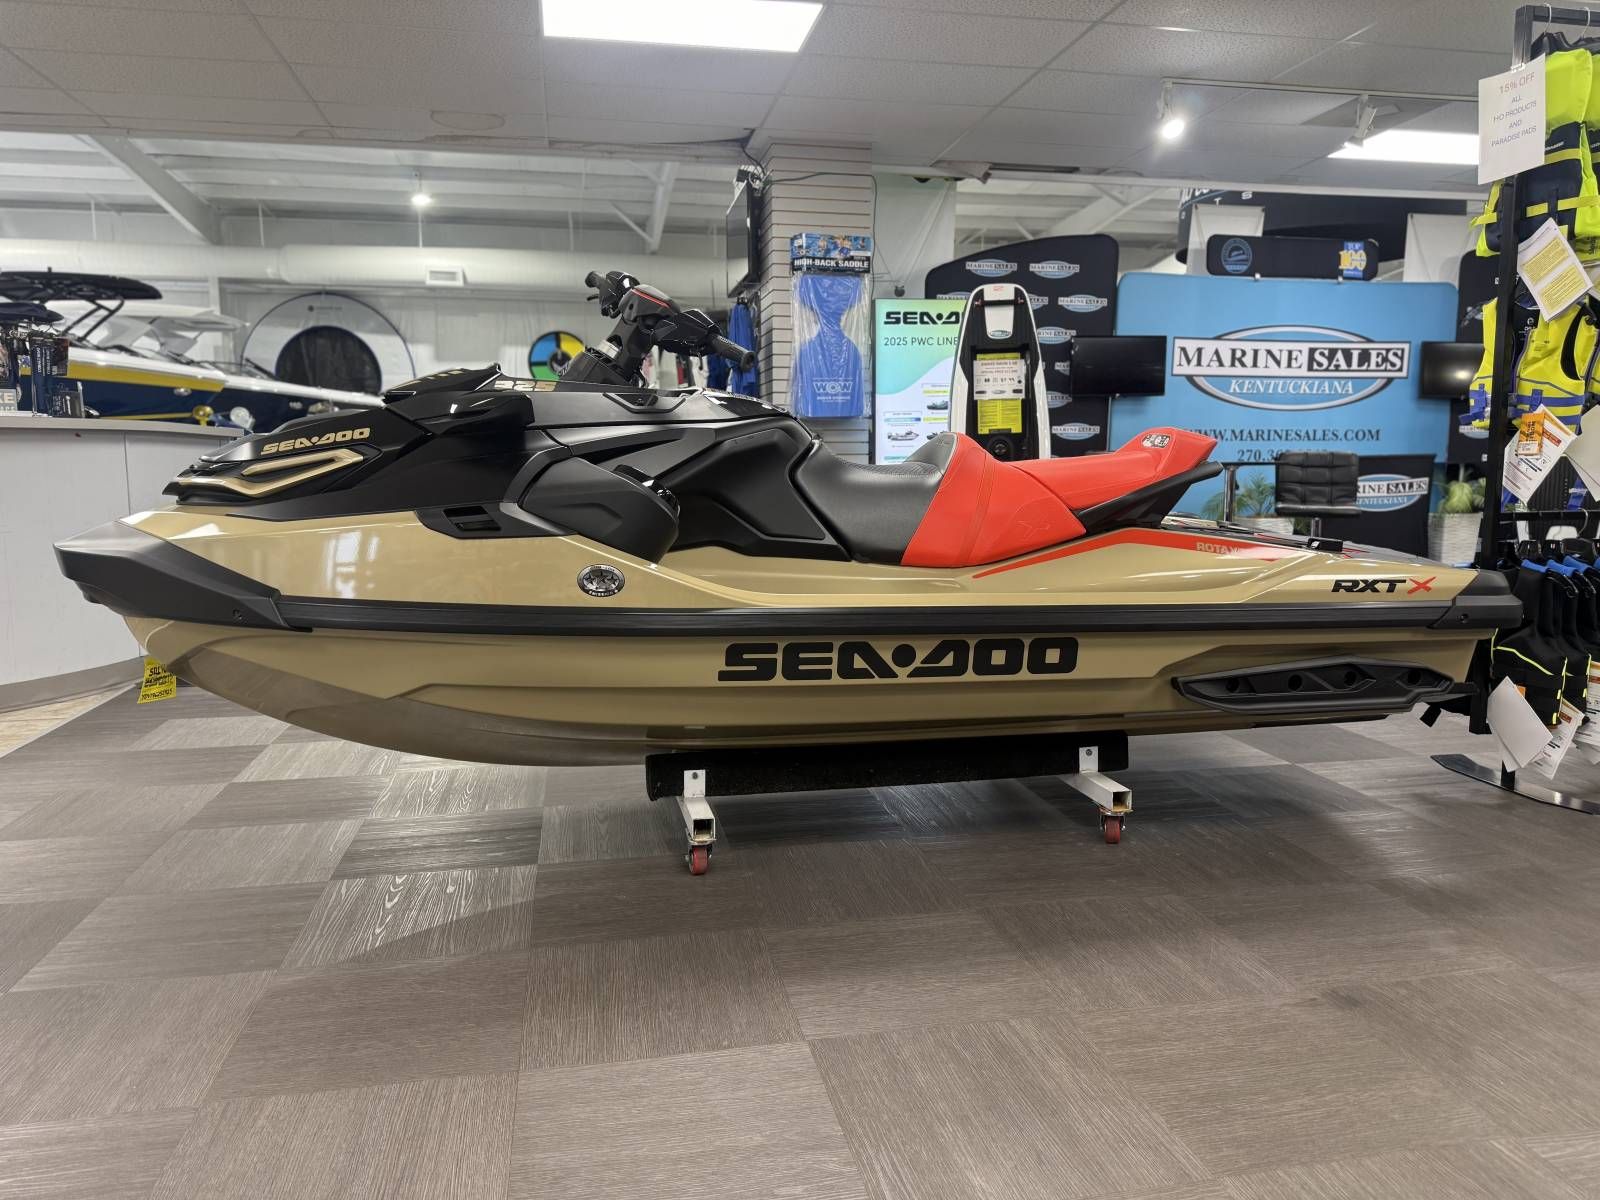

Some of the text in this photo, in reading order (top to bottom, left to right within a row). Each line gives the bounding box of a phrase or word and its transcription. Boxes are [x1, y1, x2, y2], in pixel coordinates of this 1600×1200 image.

[1499, 71, 1536, 94] 15% OFF
[1511, 95, 1523, 104] ALL
[1505, 102, 1537, 118] PRODUCTS
[794, 257, 869, 268] HIGH-BACK SADDLE
[884, 337, 958, 346] 2025 PWC LINE
[1177, 346, 1402, 371] MARINE SALES
[494, 380, 558, 392] 325
[813, 381, 853, 394] WOW
[1229, 379, 1354, 395] KENTUCKIANA
[1388, 480, 1427, 492] SALES
[1331, 579, 1406, 593] RXT
